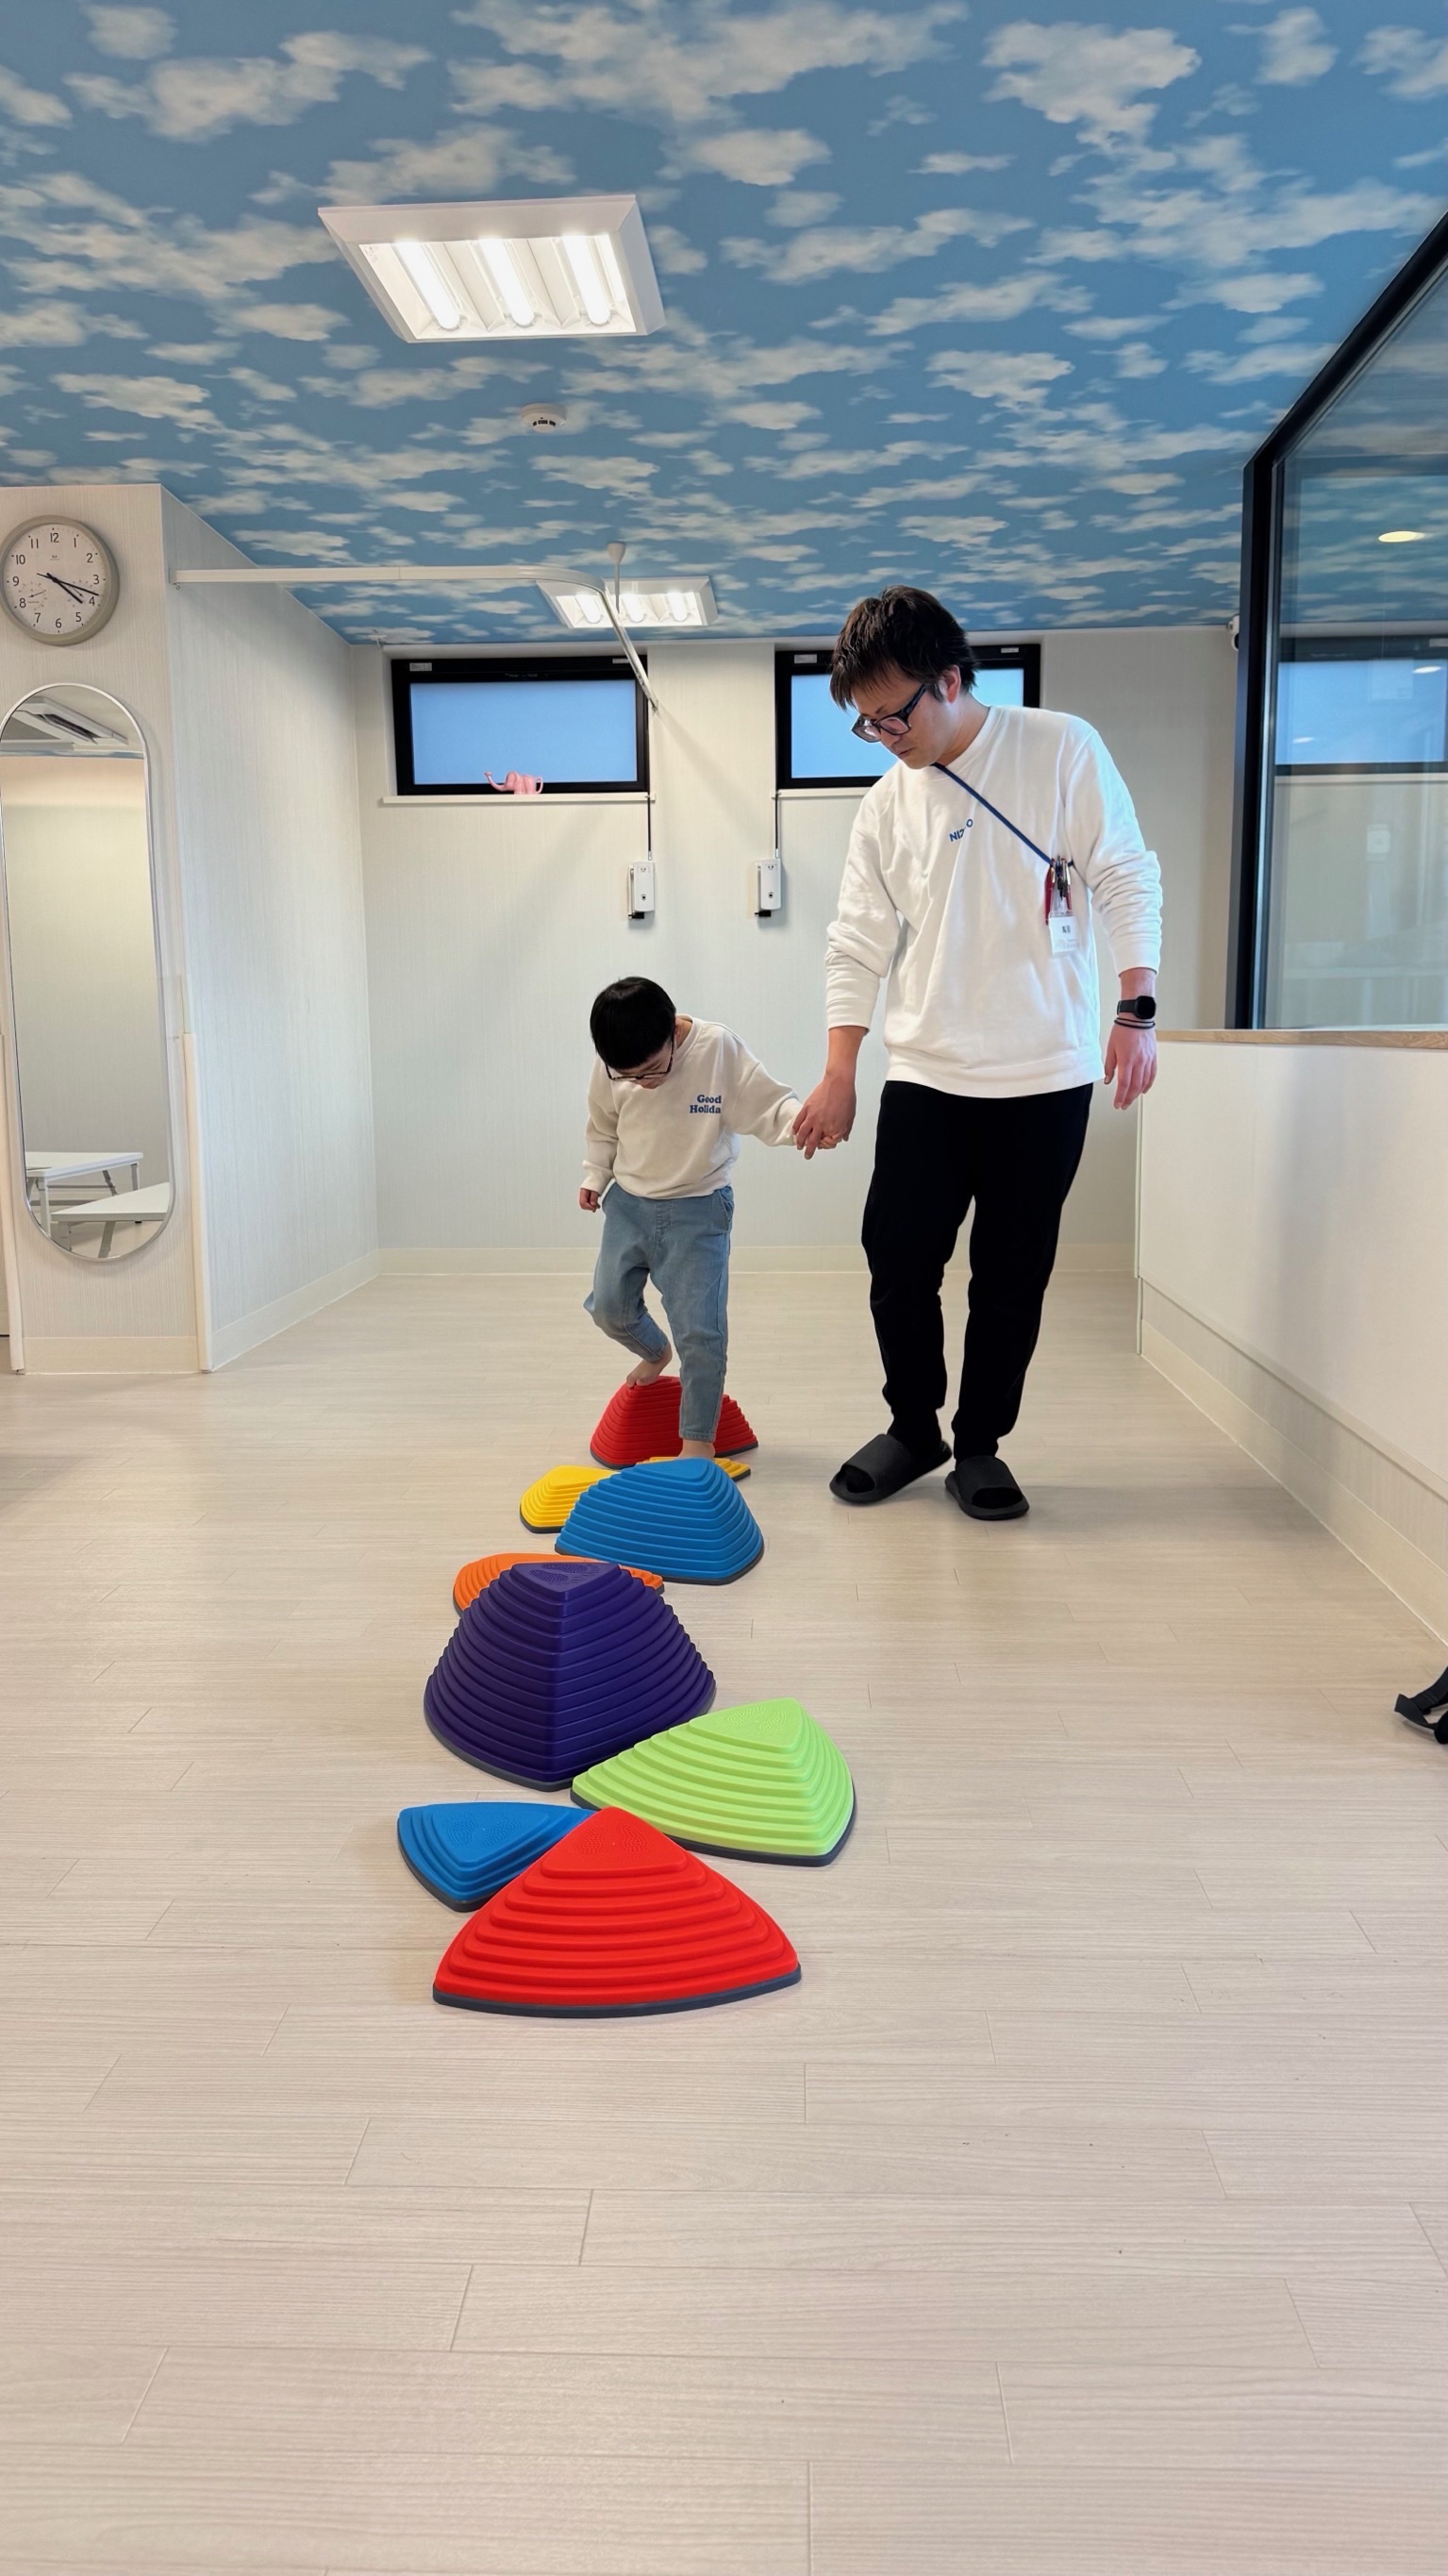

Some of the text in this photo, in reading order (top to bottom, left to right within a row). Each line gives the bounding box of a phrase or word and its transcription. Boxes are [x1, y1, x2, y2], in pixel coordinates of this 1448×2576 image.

[30, 538, 40, 549] 11
[50, 532, 59, 544] 12
[15, 554, 26, 565] 10
[86, 552, 93, 563] 2
[12, 576, 20, 587] 9
[92, 574, 100, 585] 3
[19, 597, 26, 609] 8
[89, 595, 95, 606] 4
[34, 612, 42, 623] 7
[55, 617, 62, 628] 6
[75, 611, 82, 623] 5
[697, 1095, 722, 1104] Good
[690, 1105, 721, 1113] Holida
